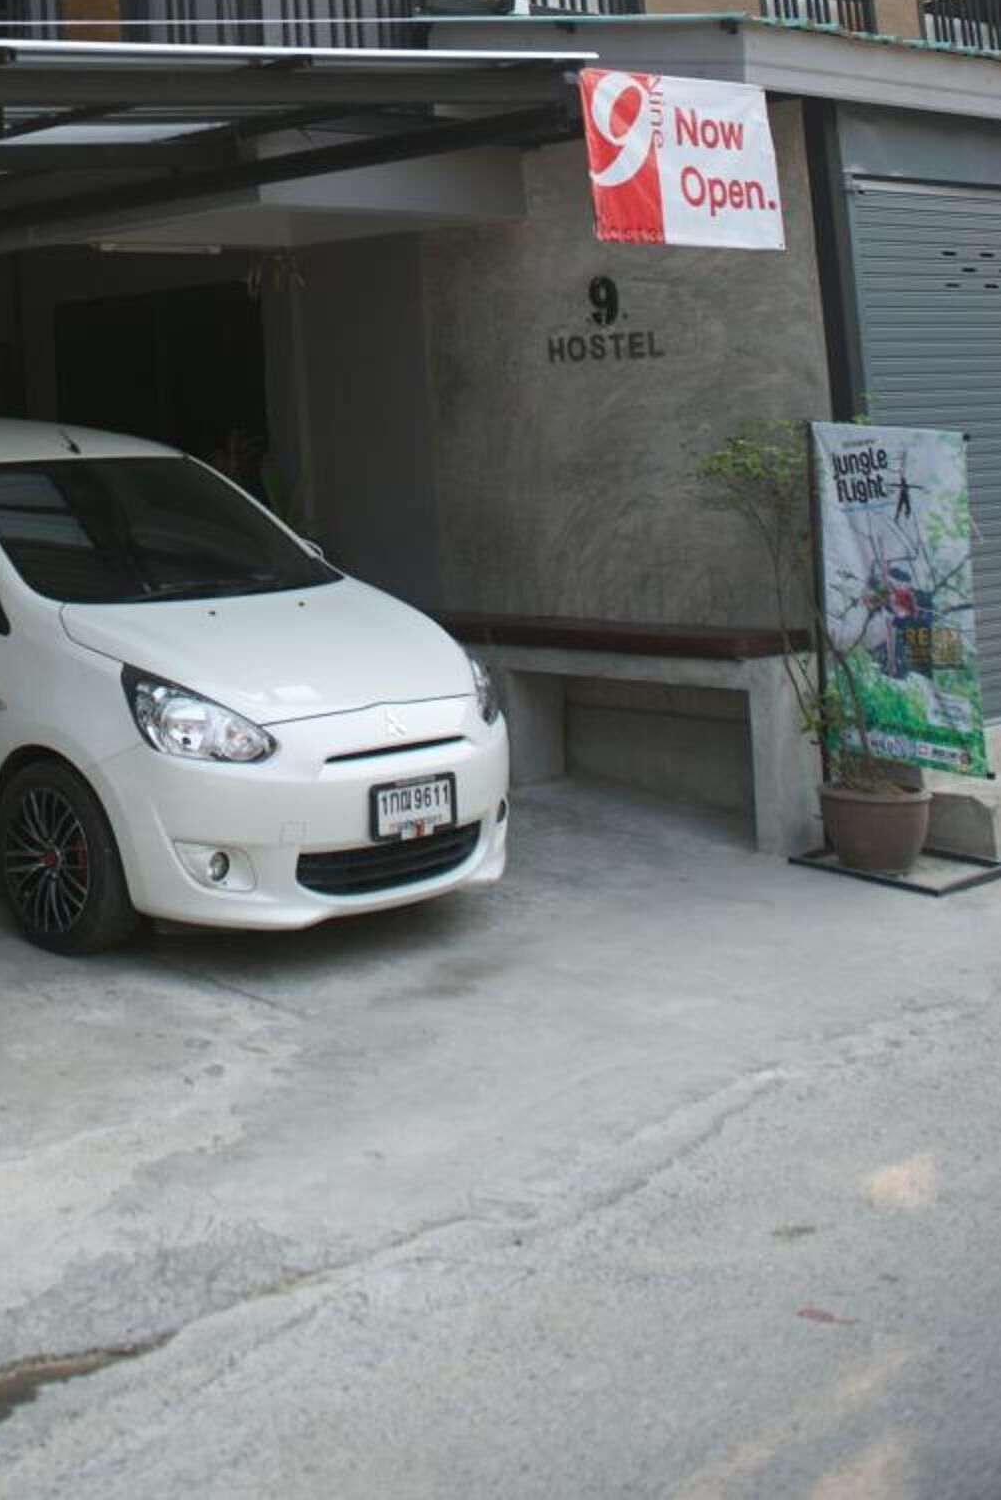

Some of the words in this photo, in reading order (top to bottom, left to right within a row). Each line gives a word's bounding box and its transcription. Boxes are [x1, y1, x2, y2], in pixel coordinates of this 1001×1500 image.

[674, 106, 744, 151] Now
[681, 166, 776, 217] Open.
[588, 276, 619, 326] 9
[548, 330, 666, 365] HOSTEL
[414, 783, 448, 810] 9611
